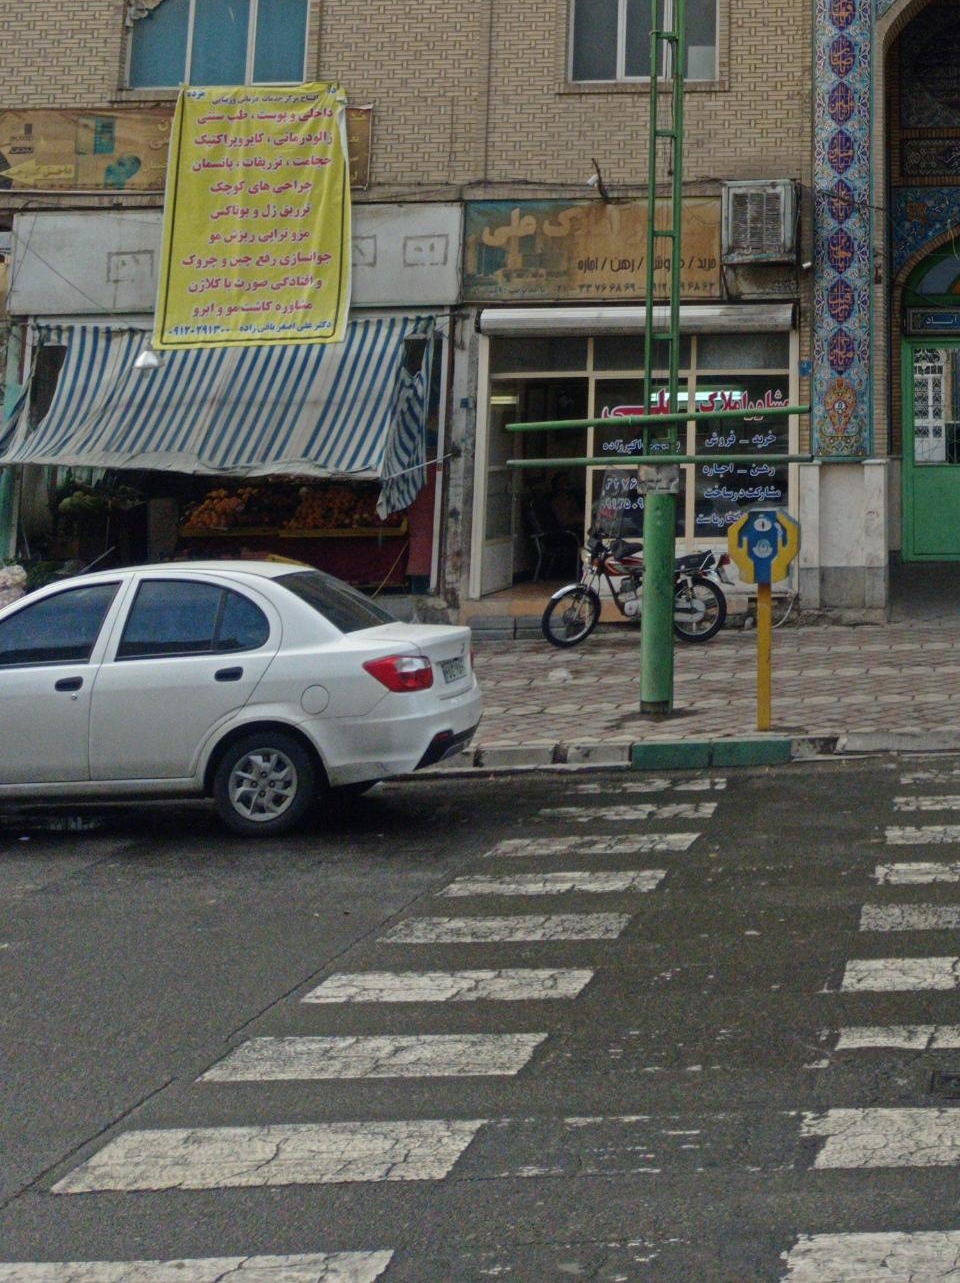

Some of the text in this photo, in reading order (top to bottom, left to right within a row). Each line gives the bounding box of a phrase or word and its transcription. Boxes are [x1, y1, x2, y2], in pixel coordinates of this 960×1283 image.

[196, 111, 225, 125] سنتی
[299, 108, 333, 123] داخلی
[209, 180, 313, 195] جراحی های کوچک
[279, 203, 312, 218] تزریق
[208, 235, 222, 244] مو
[255, 254, 277, 267] رفع
[278, 252, 333, 267] جوانسازی
[609, 258, 636, 273] رهن
[233, 280, 269, 291] صورت
[270, 275, 314, 290] افتادگی
[192, 303, 215, 318] ابرو
[224, 304, 239, 316] مو
[240, 300, 273, 313] کاشت
[274, 299, 314, 315] مشاوره
[704, 429, 737, 448] فروش
[752, 429, 777, 449] خرید
[702, 463, 776, 478] رهن اجاره
[744, 485, 782, 502] مشارکت
